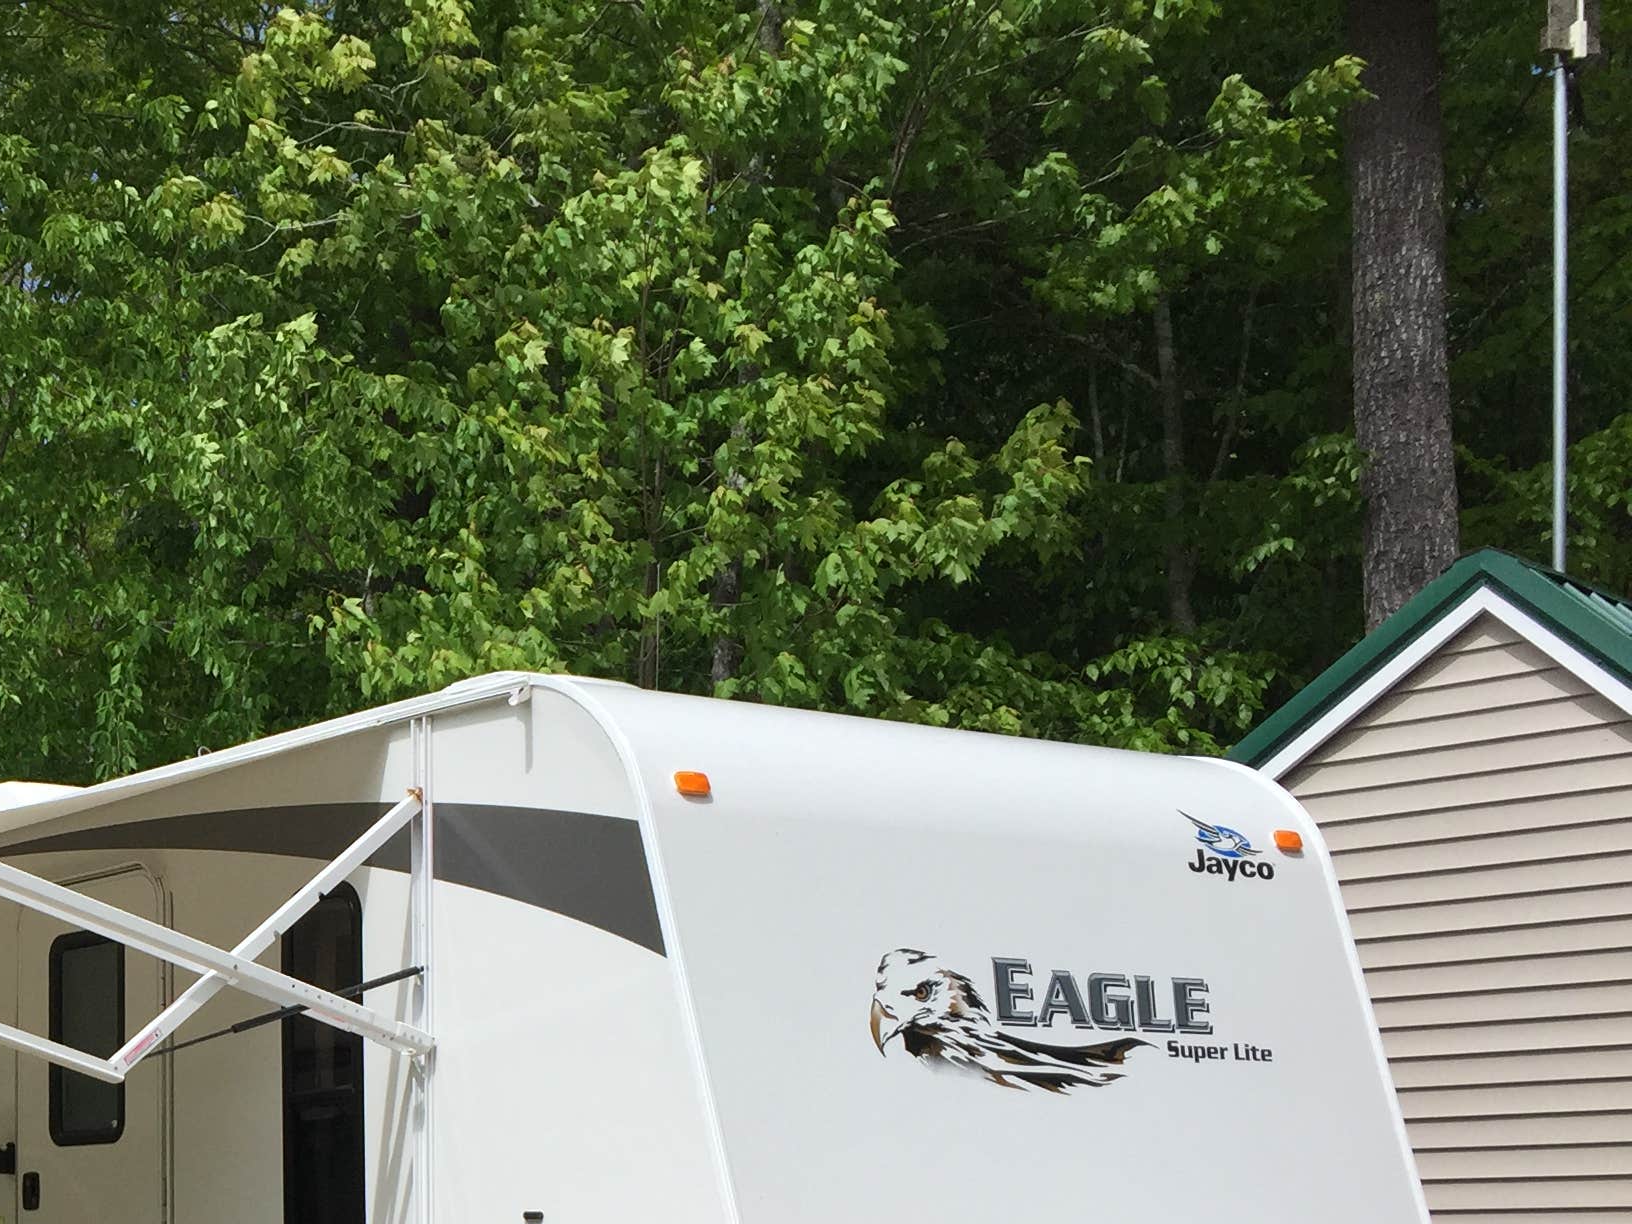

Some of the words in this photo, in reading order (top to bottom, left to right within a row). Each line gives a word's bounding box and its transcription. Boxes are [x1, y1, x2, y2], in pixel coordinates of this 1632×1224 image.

[1188, 849, 1274, 881] Jayco
[991, 956, 1213, 1034] EAGLE
[1167, 1040, 1228, 1062] Super
[1233, 1043, 1273, 1062] Lite
